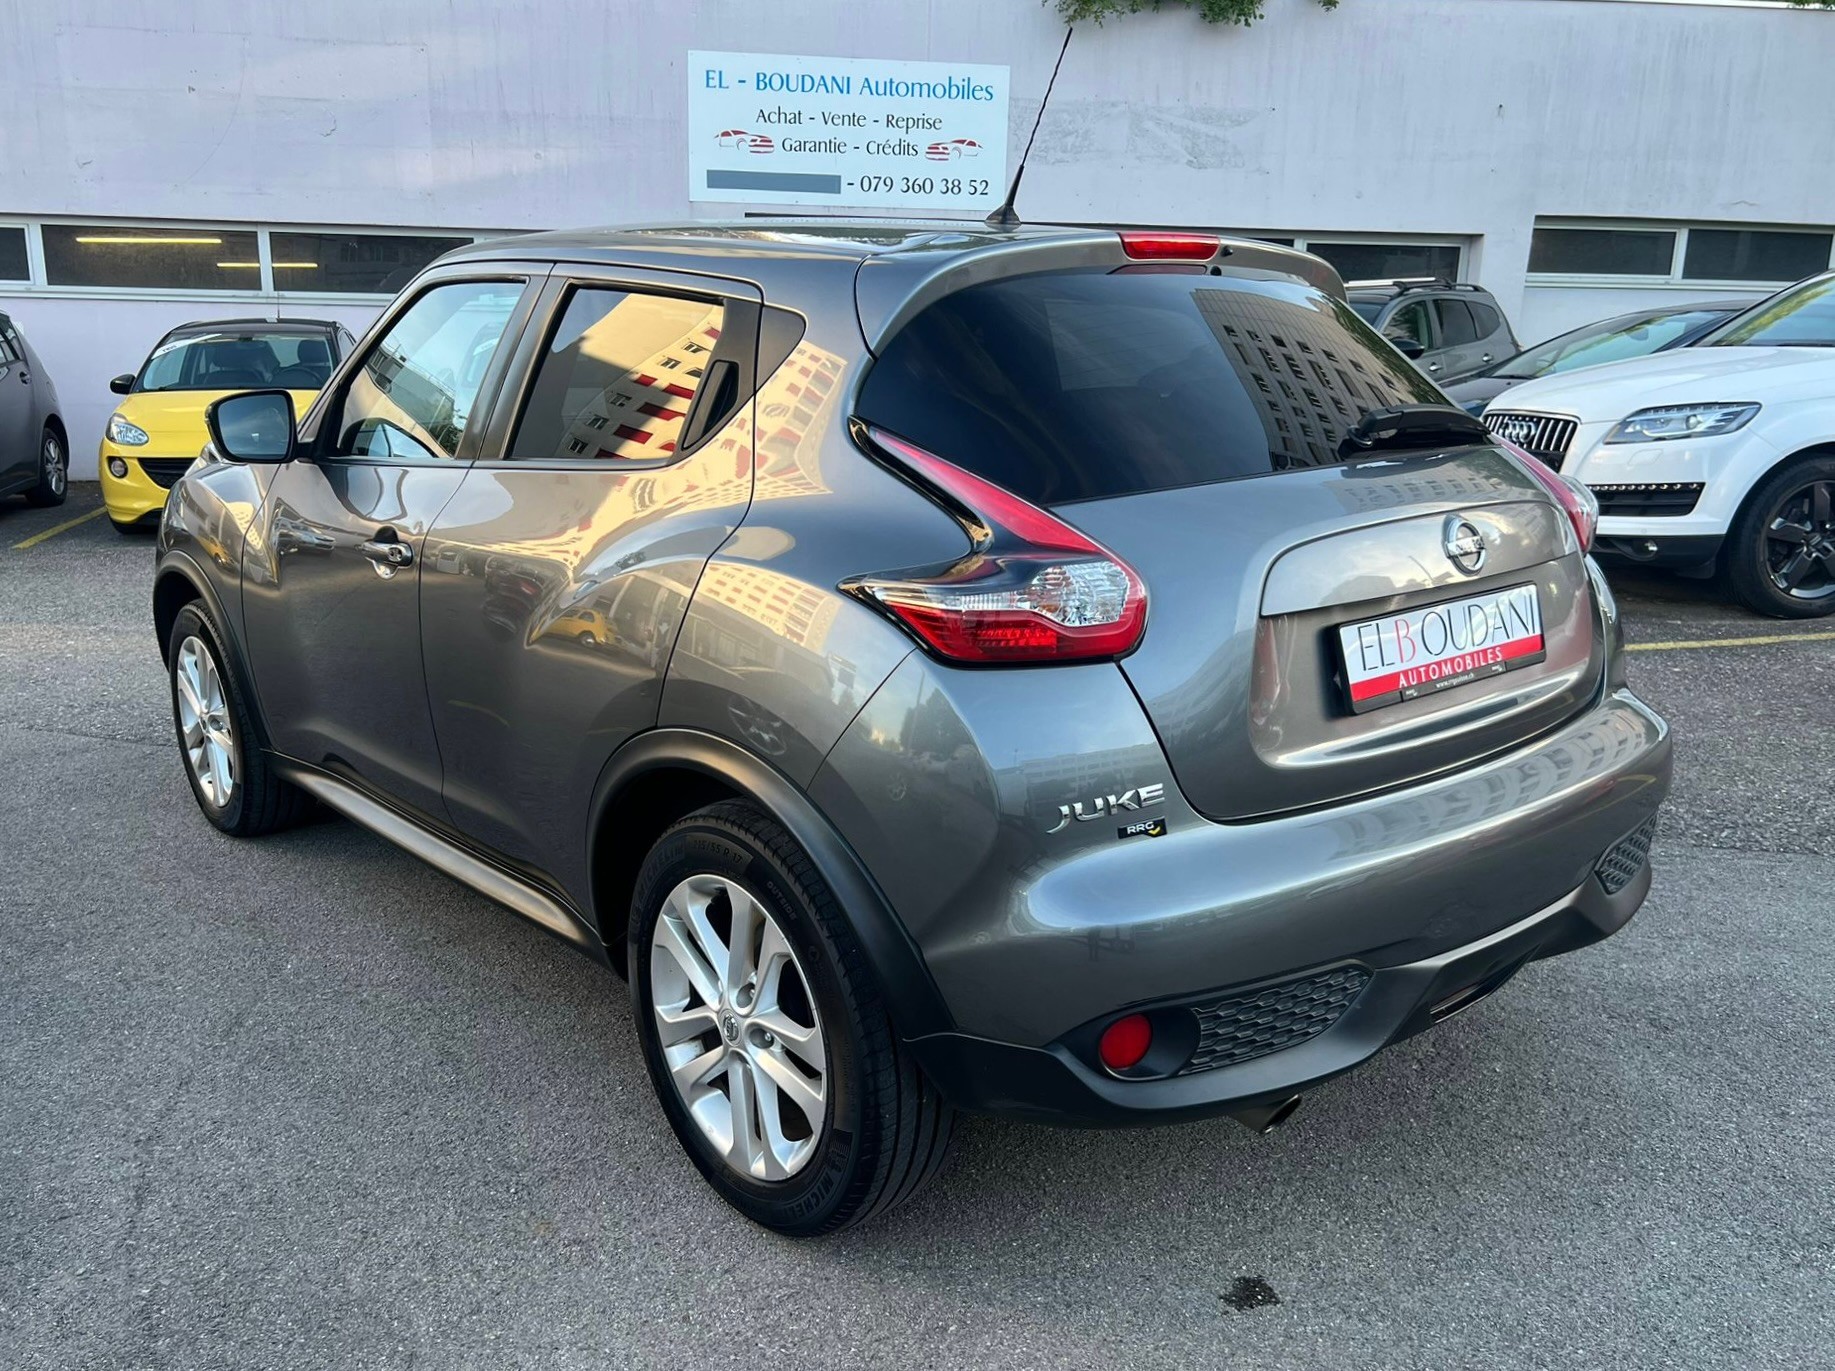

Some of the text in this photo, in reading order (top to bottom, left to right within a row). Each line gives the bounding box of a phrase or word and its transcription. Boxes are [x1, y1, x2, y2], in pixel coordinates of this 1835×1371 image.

[704, 69, 730, 89] EL
[755, 72, 851, 95] BOUDANI
[859, 76, 994, 101] Automobiles
[755, 106, 803, 125] Achat
[821, 111, 867, 127] Vente
[885, 113, 943, 134] Reprise
[781, 137, 848, 154] Garantie
[866, 138, 919, 157] Crédits
[860, 175, 894, 194] 079
[901, 177, 934, 195] 360
[940, 178, 962, 195] 38
[968, 179, 989, 196] 52
[1398, 647, 1503, 689] AUTOMOBILES
[1046, 783, 1166, 834] JUKE
[1126, 821, 1155, 835] RRG
